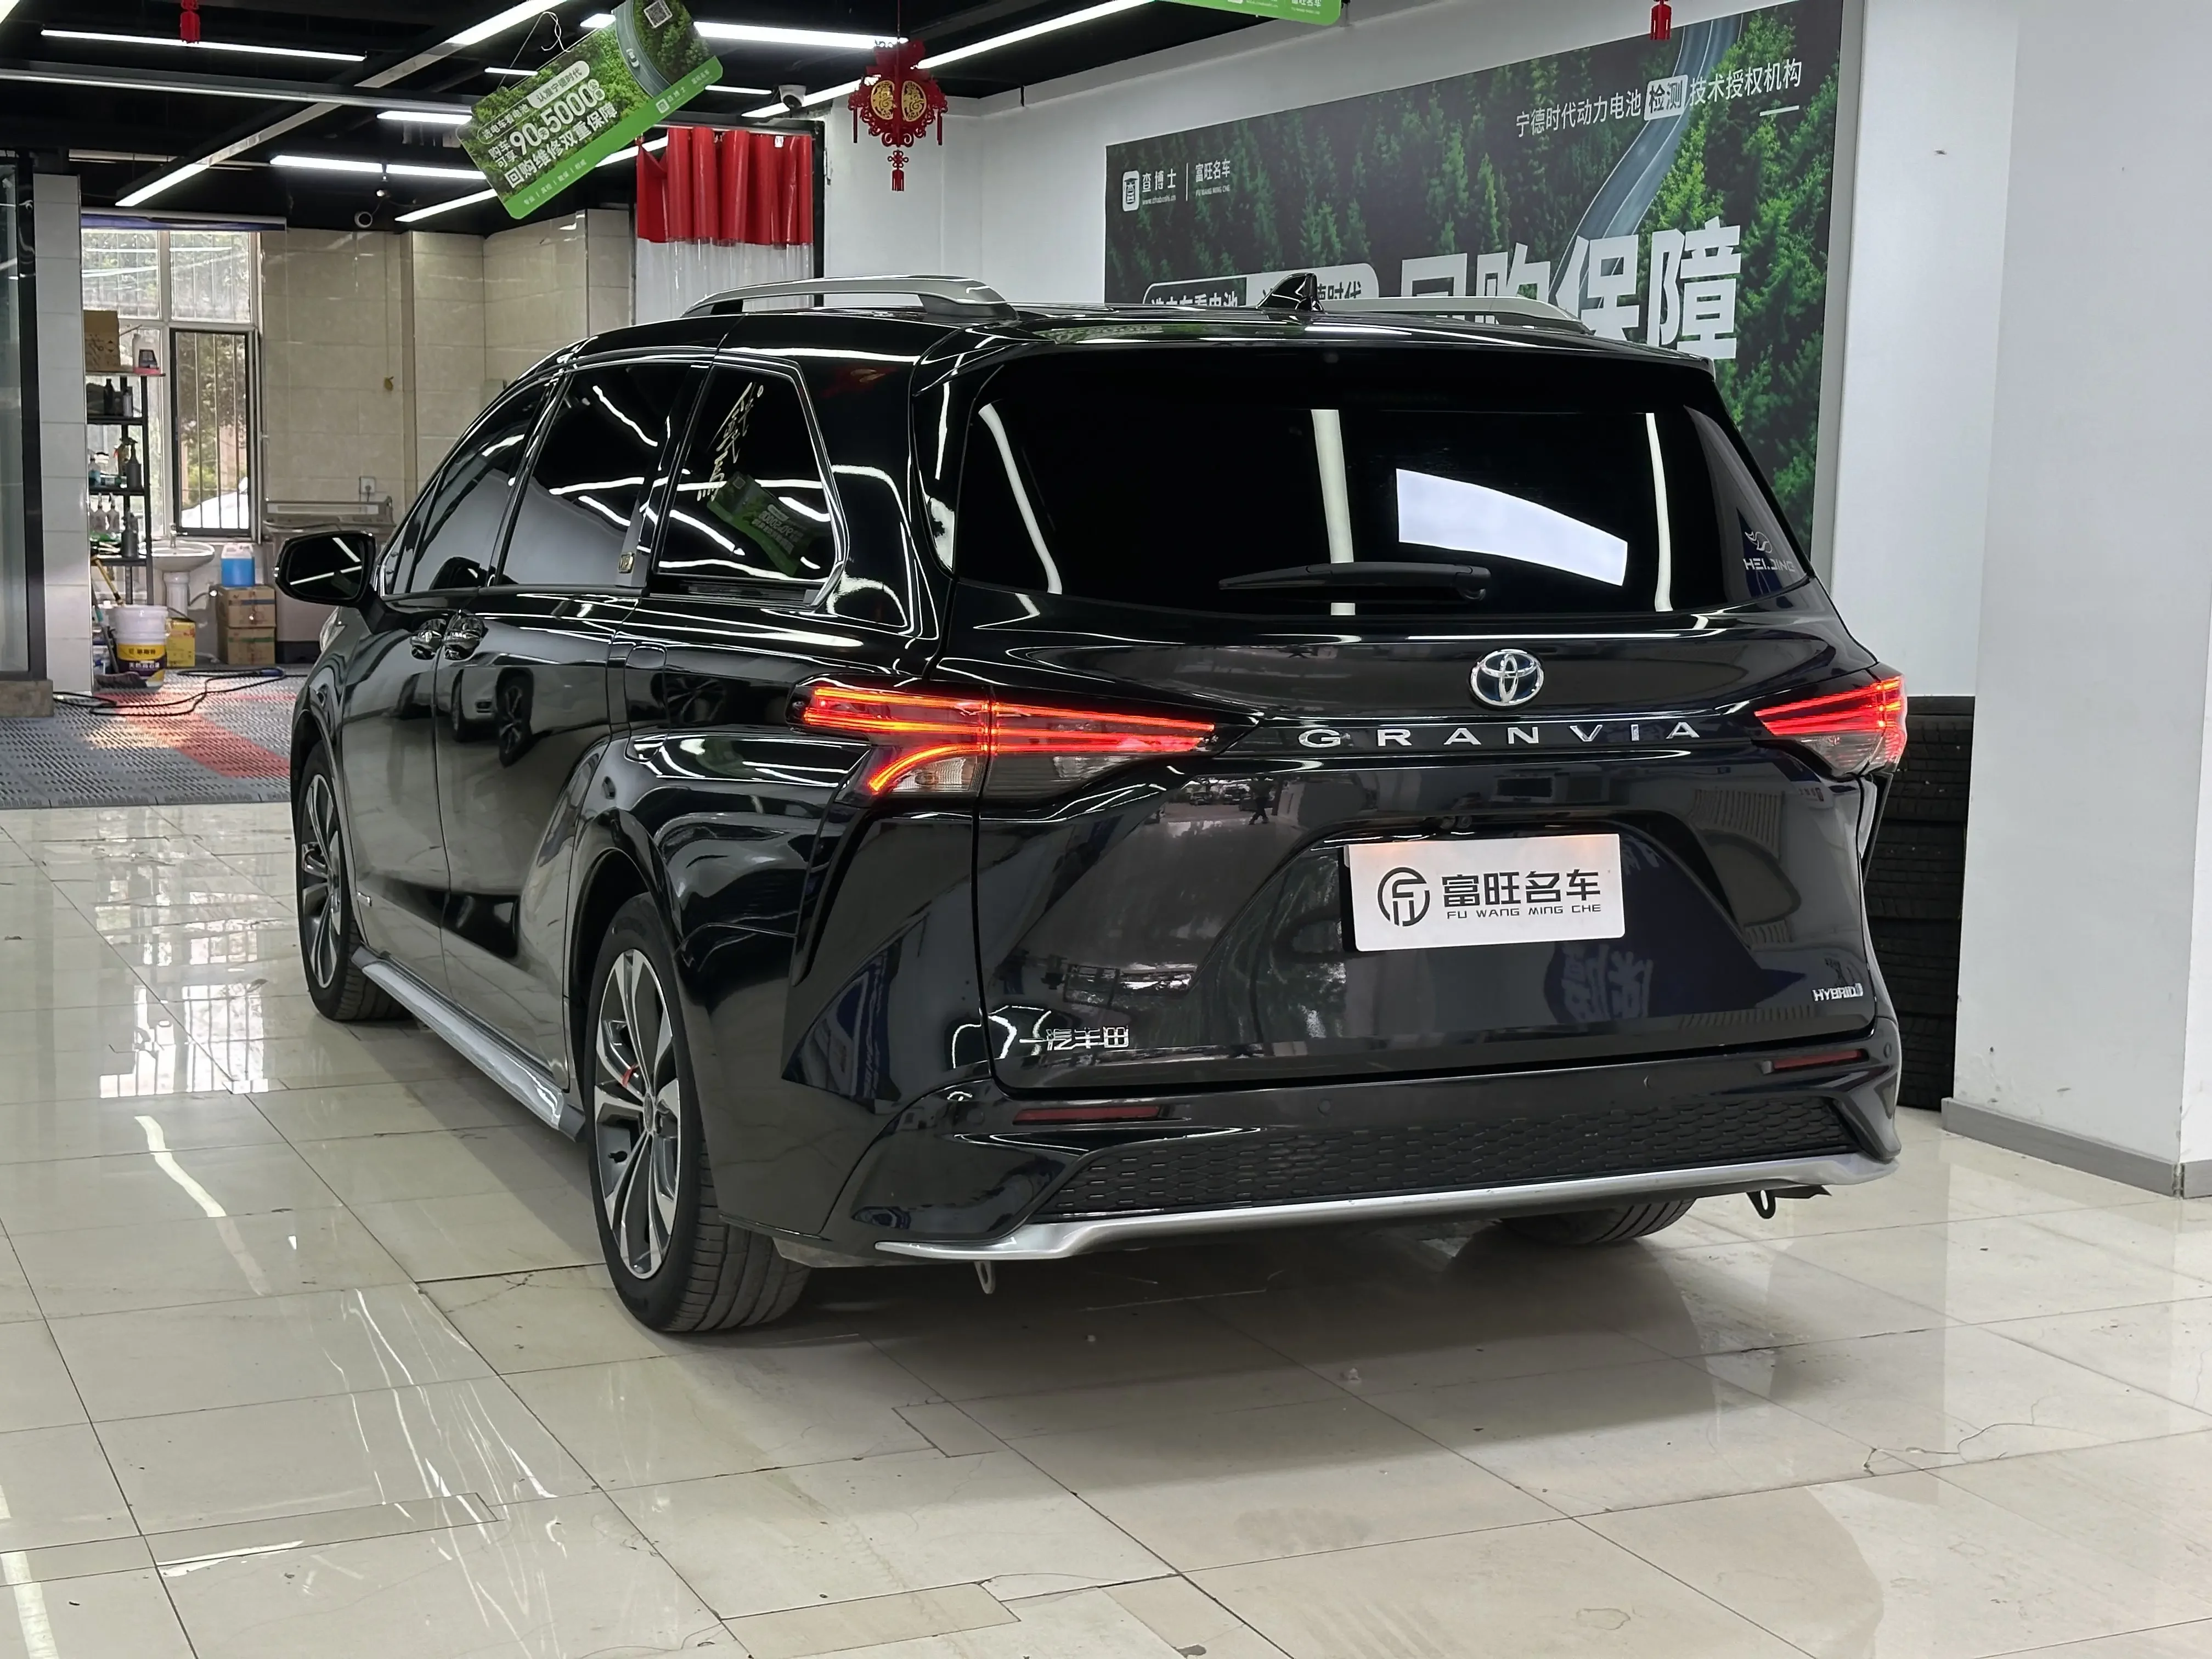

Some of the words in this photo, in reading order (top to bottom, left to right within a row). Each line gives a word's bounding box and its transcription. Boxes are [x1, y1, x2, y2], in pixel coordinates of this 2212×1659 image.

[482, 104, 530, 139] 选电车看电池
[536, 67, 583, 103] 认准宁德时代
[504, 101, 618, 189] 回购维修双重保障
[1142, 168, 1176, 193] 查博士
[1195, 158, 1231, 183] 富旺名车
[1297, 720, 1701, 748] GRANVIA
[1441, 868, 1601, 908] 富旺名车
[1447, 910, 1468, 919] FU
[1476, 908, 1520, 918] WANG
[1528, 905, 1564, 916] MING
[1571, 904, 1601, 913] CHE
[1019, 1026, 1129, 1051] 一汽丰田
